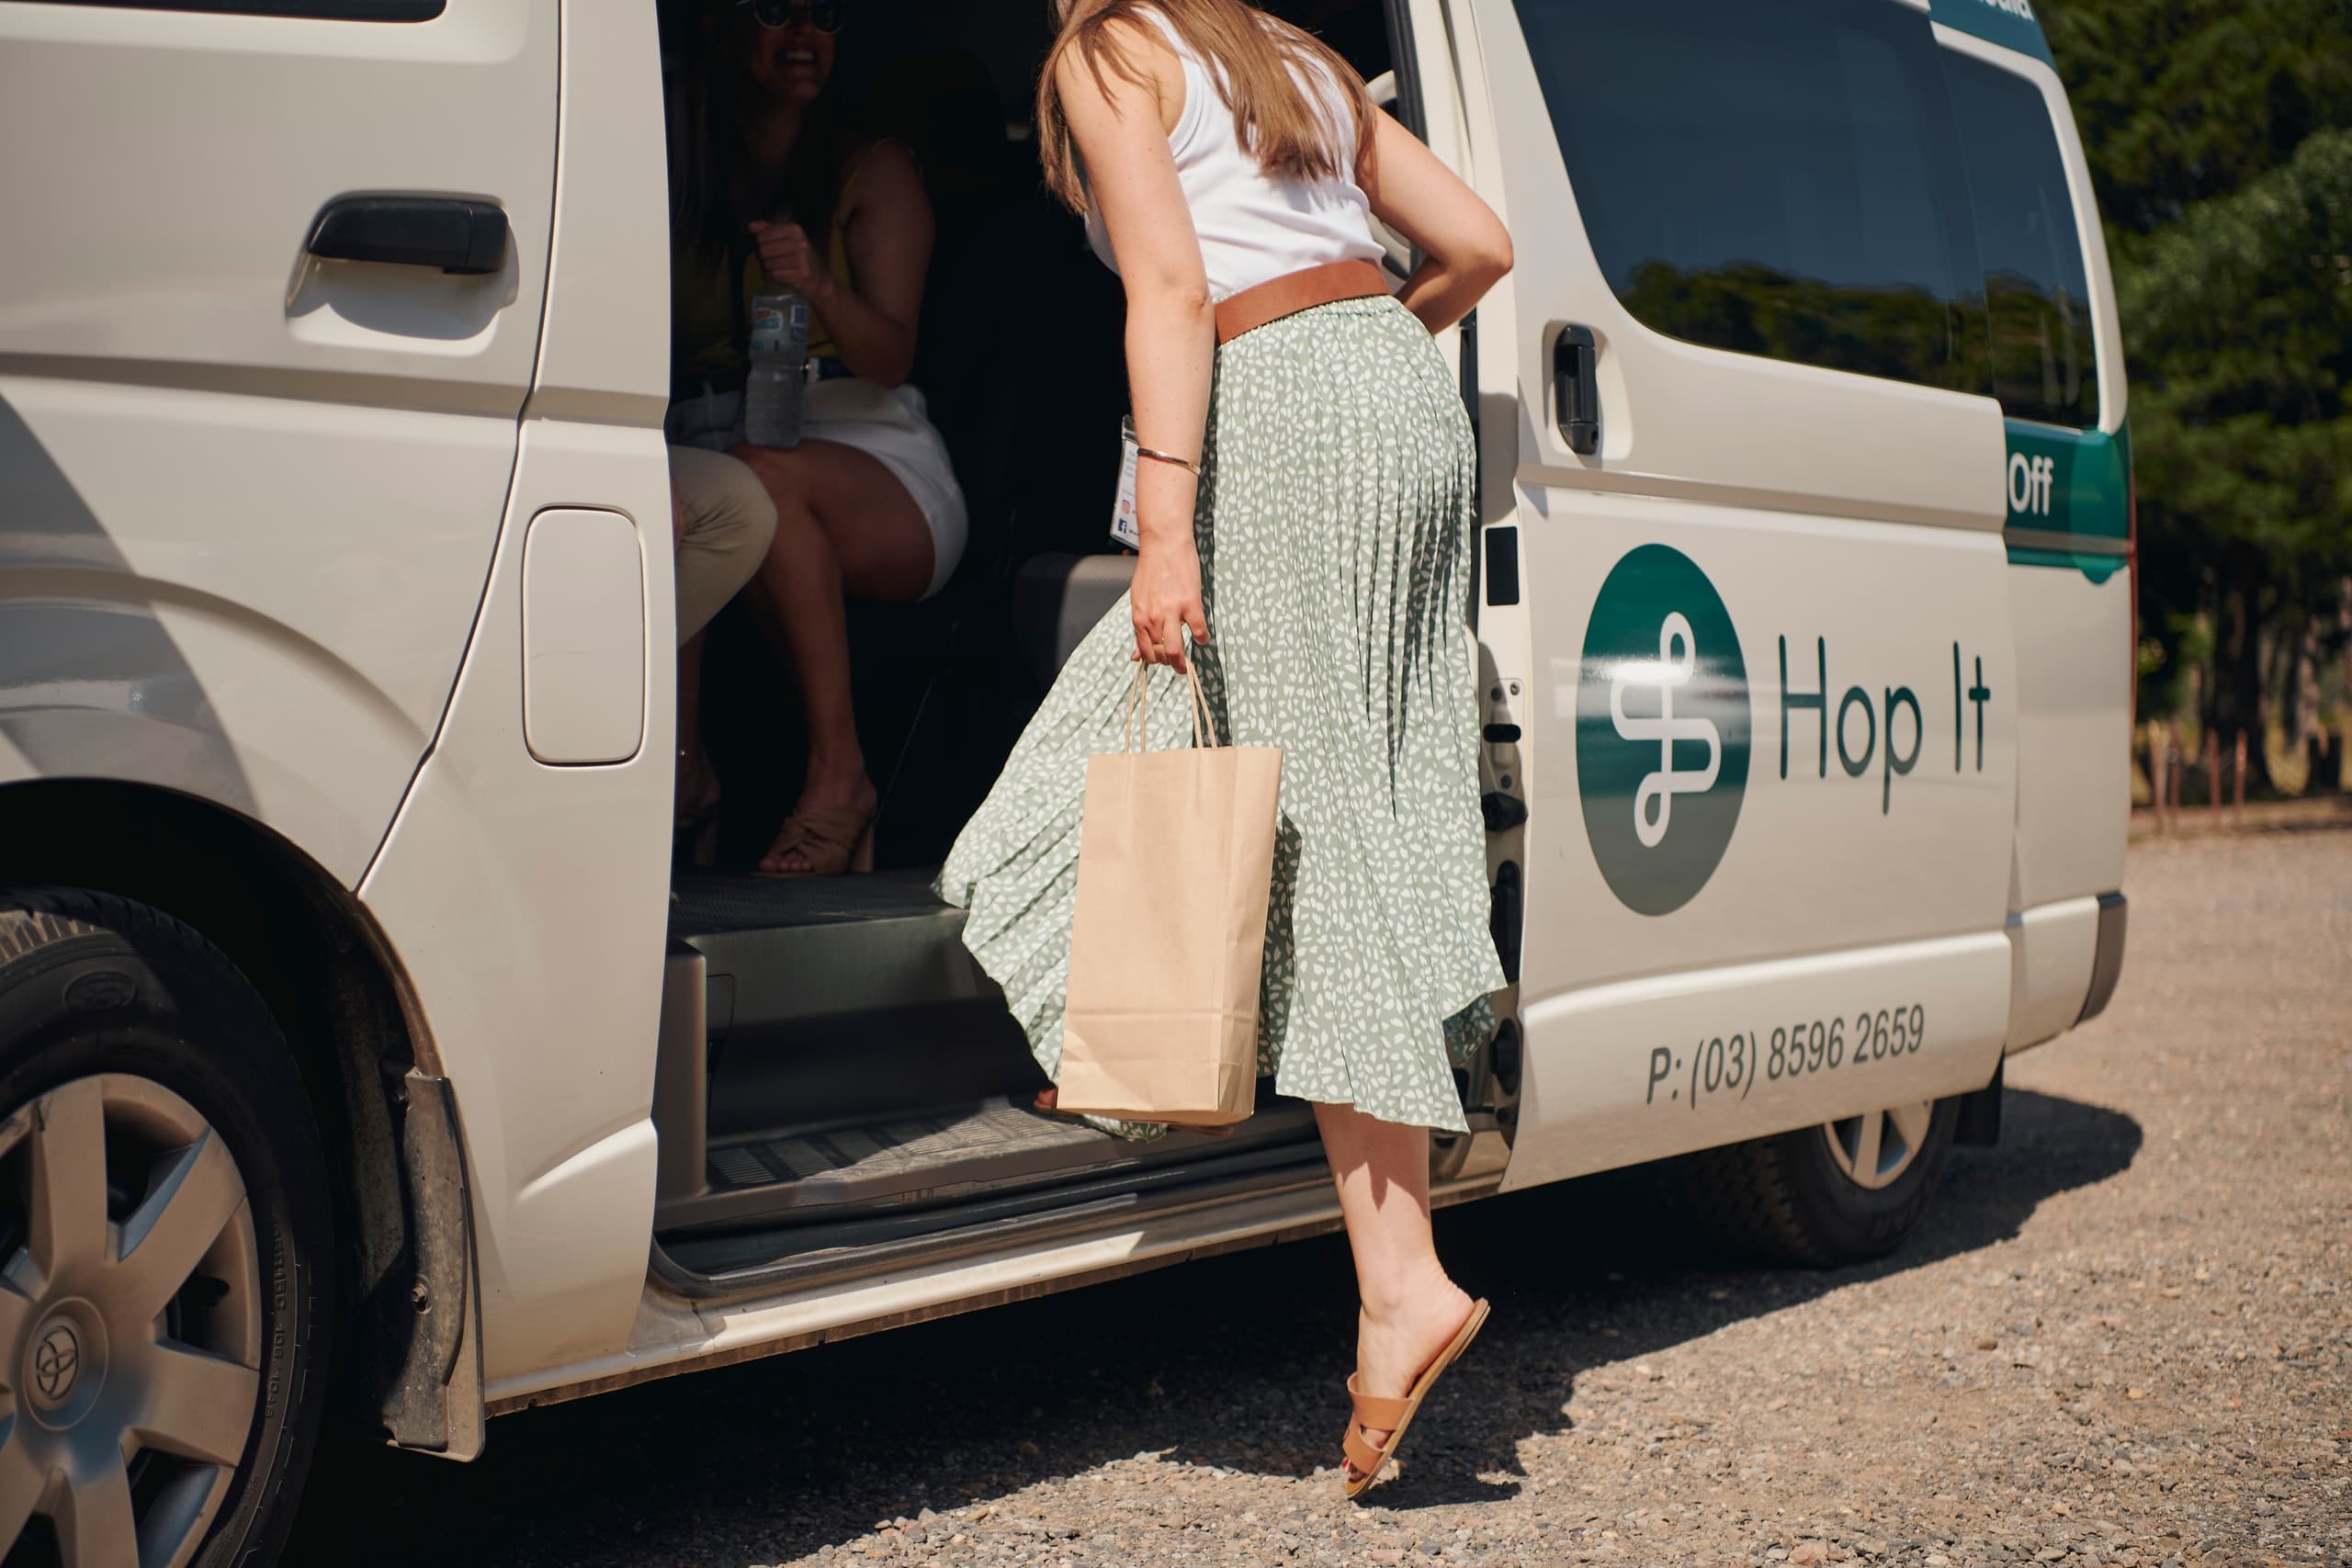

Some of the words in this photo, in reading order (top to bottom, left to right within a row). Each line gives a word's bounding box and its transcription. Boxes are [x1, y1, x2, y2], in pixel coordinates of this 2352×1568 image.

[2008, 452, 2054, 516] Off
[1779, 634, 1923, 816] Hop
[1953, 639, 1991, 773] It
[1690, 1032, 1757, 1110] (03)
[1768, 1017, 1845, 1081] 8596
[1853, 1003, 1925, 1064] 2659
